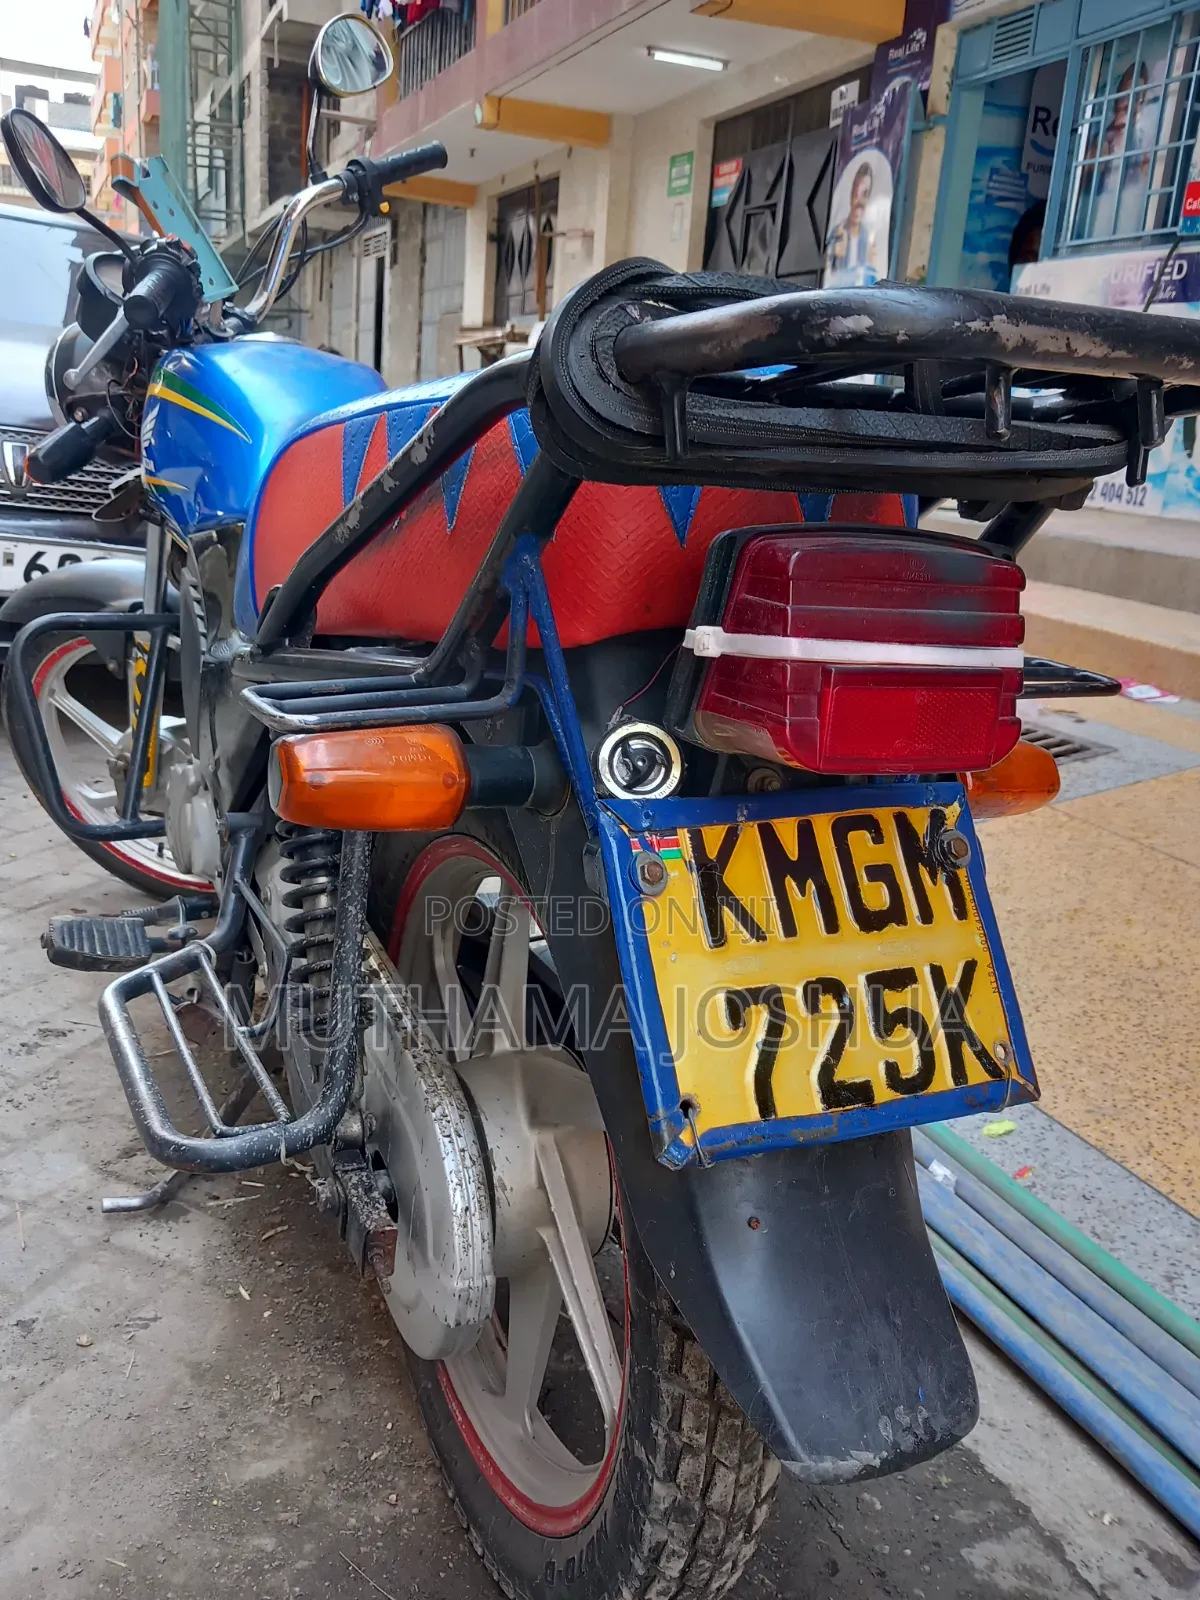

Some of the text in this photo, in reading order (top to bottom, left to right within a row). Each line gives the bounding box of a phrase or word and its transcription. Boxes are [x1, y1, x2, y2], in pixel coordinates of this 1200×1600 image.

[888, 44, 905, 61] Real
[1101, 482, 1125, 503] 404
[1126, 486, 1148, 507] 512
[688, 809, 968, 949] KMGM
[718, 957, 1006, 1121] 725K
